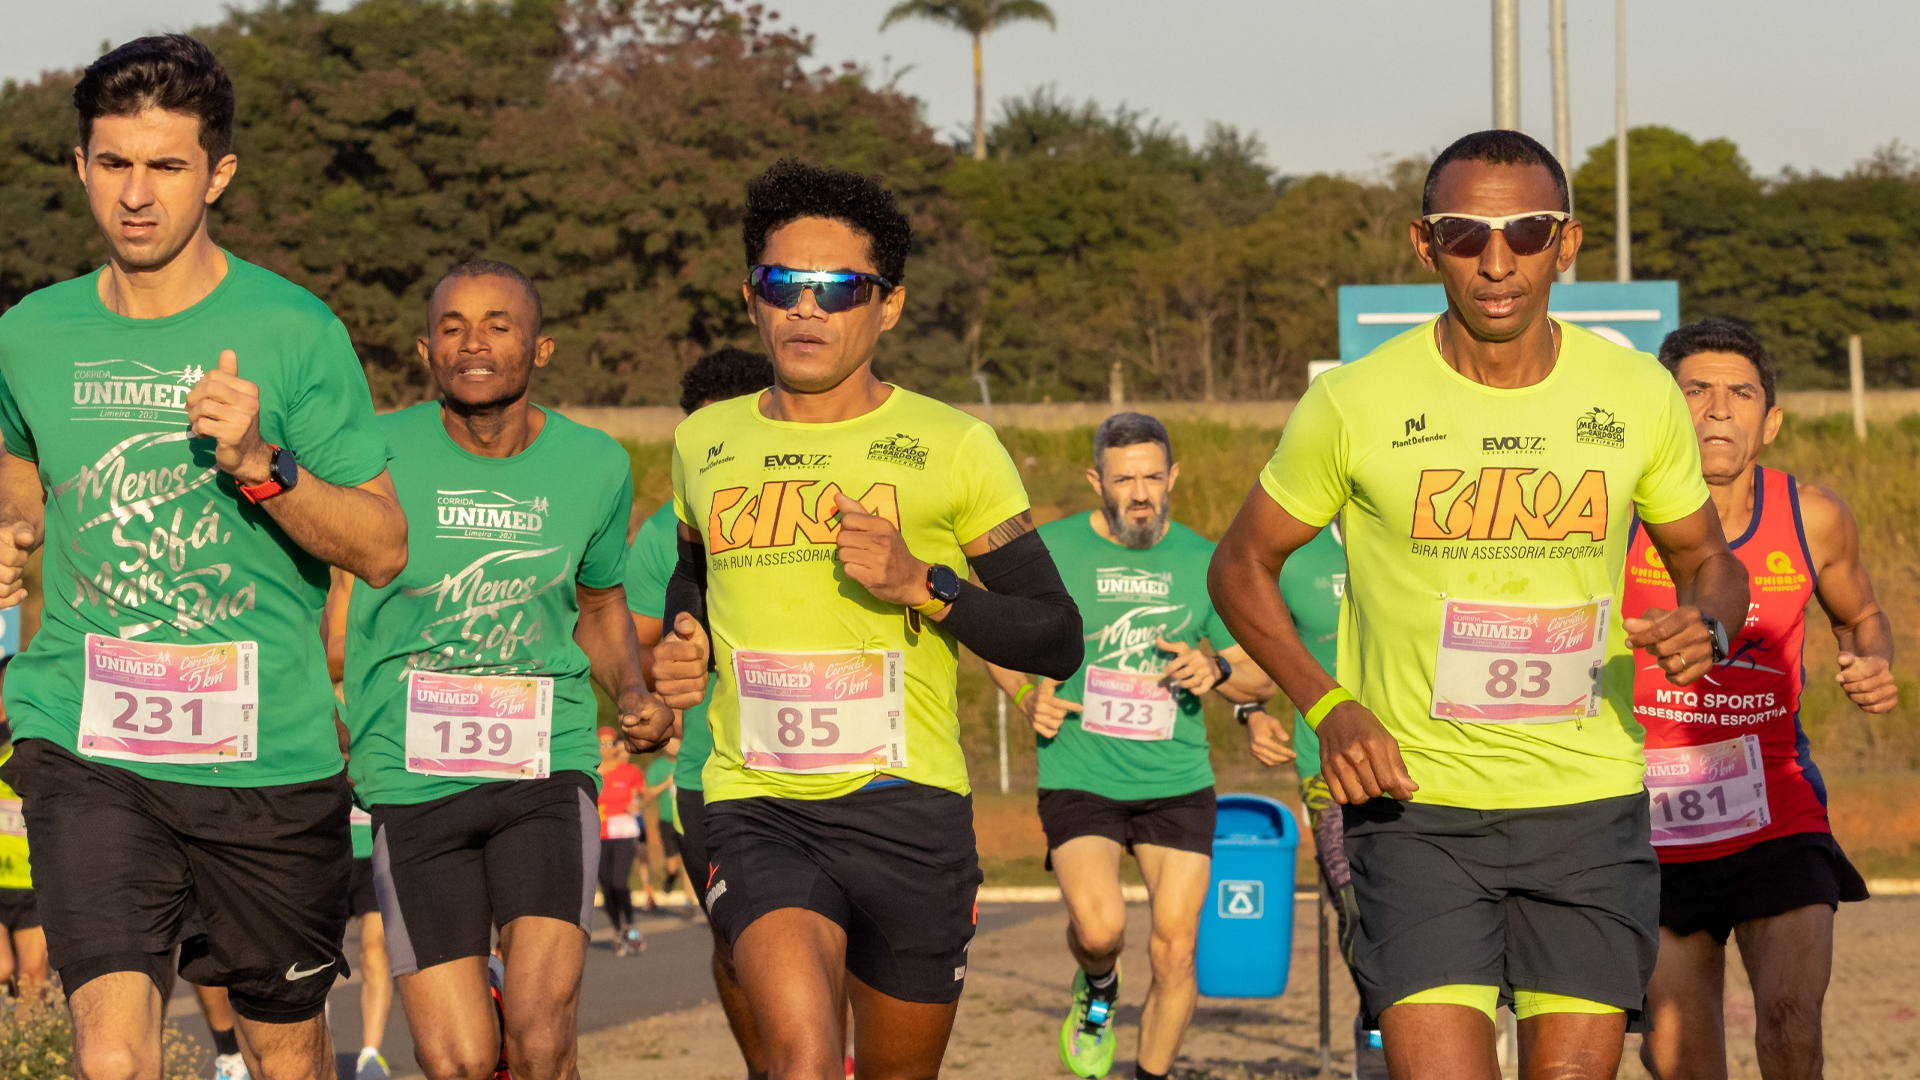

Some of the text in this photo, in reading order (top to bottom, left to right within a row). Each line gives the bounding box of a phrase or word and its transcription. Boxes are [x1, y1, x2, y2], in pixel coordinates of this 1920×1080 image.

[74, 370, 111, 379] CORRIDA
[73, 381, 191, 408] UNIMED
[100, 409, 130, 418] Limeira
[138, 411, 158, 419] 2023
[1579, 421, 1622, 433] MERCADO
[873, 443, 925, 457] MERCADO
[78, 456, 188, 515] Menos
[438, 497, 474, 506] CORRIDA
[437, 506, 542, 531] UNIMED
[464, 530, 492, 538] Limeira
[499, 532, 516, 540] 2023
[713, 555, 729, 571] BIRA
[730, 553, 752, 569] RUN
[756, 549, 831, 566] ASSESSORIA
[1411, 543, 1605, 560] BIRA RUN ASSESSORIA ESPORTIVA
[1631, 566, 1670, 580] UNIBR
[435, 568, 536, 612] Menos
[1097, 579, 1169, 595] UNIMED
[1452, 621, 1533, 640] UNIMED
[95, 654, 166, 677] UNIMED
[745, 670, 812, 688] UNIMED
[1485, 658, 1552, 699] 83
[417, 690, 479, 705] UNIMED
[1656, 689, 1775, 709] MTQ SPORTS
[113, 691, 203, 736] 231
[1101, 700, 1153, 725] 123
[778, 707, 840, 747] 85
[433, 721, 513, 756] 139
[1644, 764, 1690, 777] NIMED
[1653, 785, 1727, 822] 181
